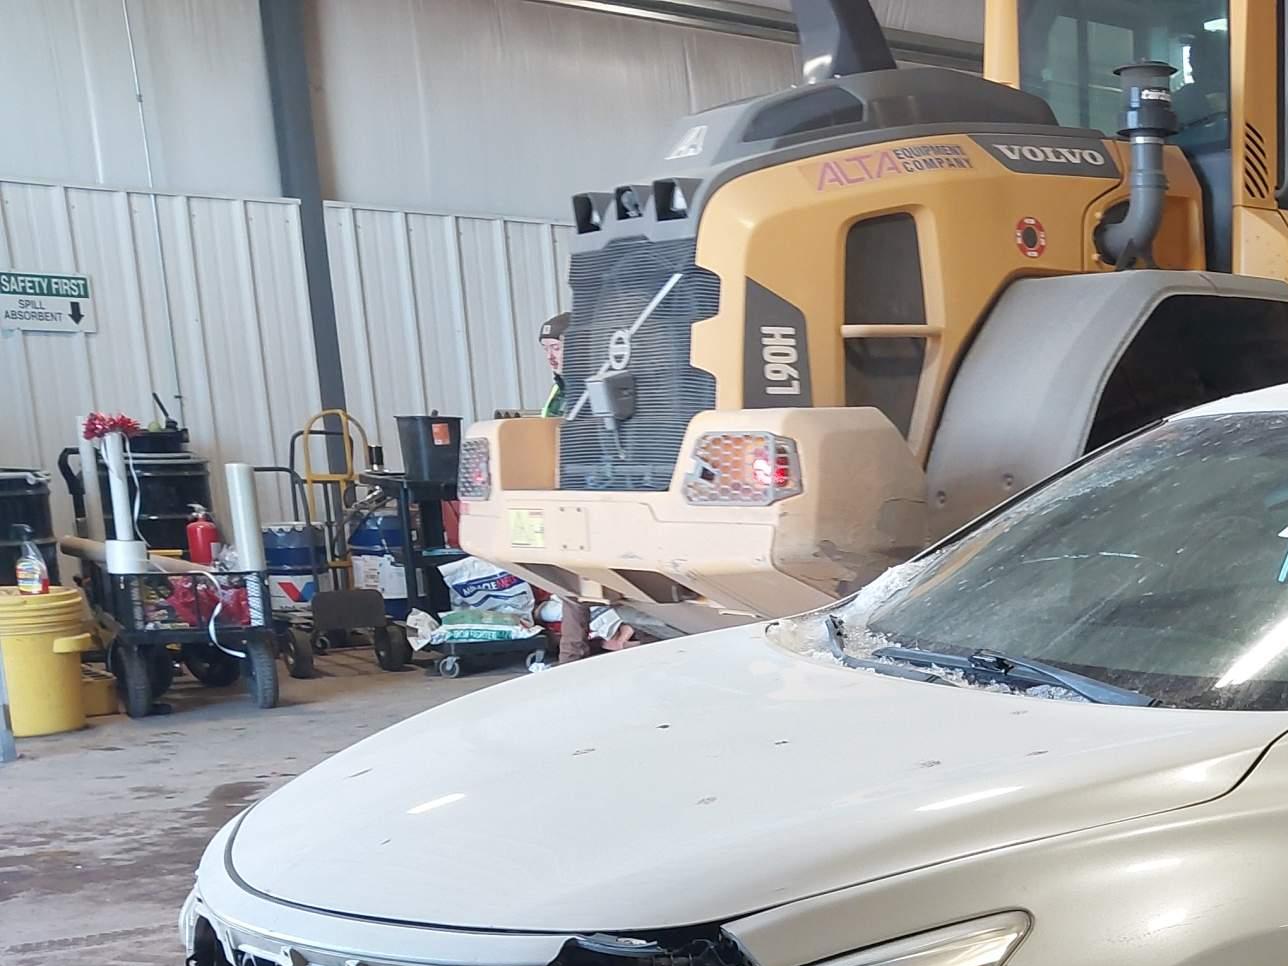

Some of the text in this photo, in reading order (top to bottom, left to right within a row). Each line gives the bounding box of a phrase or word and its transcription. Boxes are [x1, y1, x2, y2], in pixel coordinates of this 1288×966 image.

[891, 143, 965, 160] EQUIPMENT
[992, 143, 1106, 166] VOLVO
[816, 151, 902, 191] ALTA
[902, 156, 974, 173] COMPANY
[0, 274, 85, 296] SAFETY FIRST
[18, 299, 46, 310] SPILL
[4, 310, 63, 322] ABSORBENT
[760, 326, 801, 395] L90H
